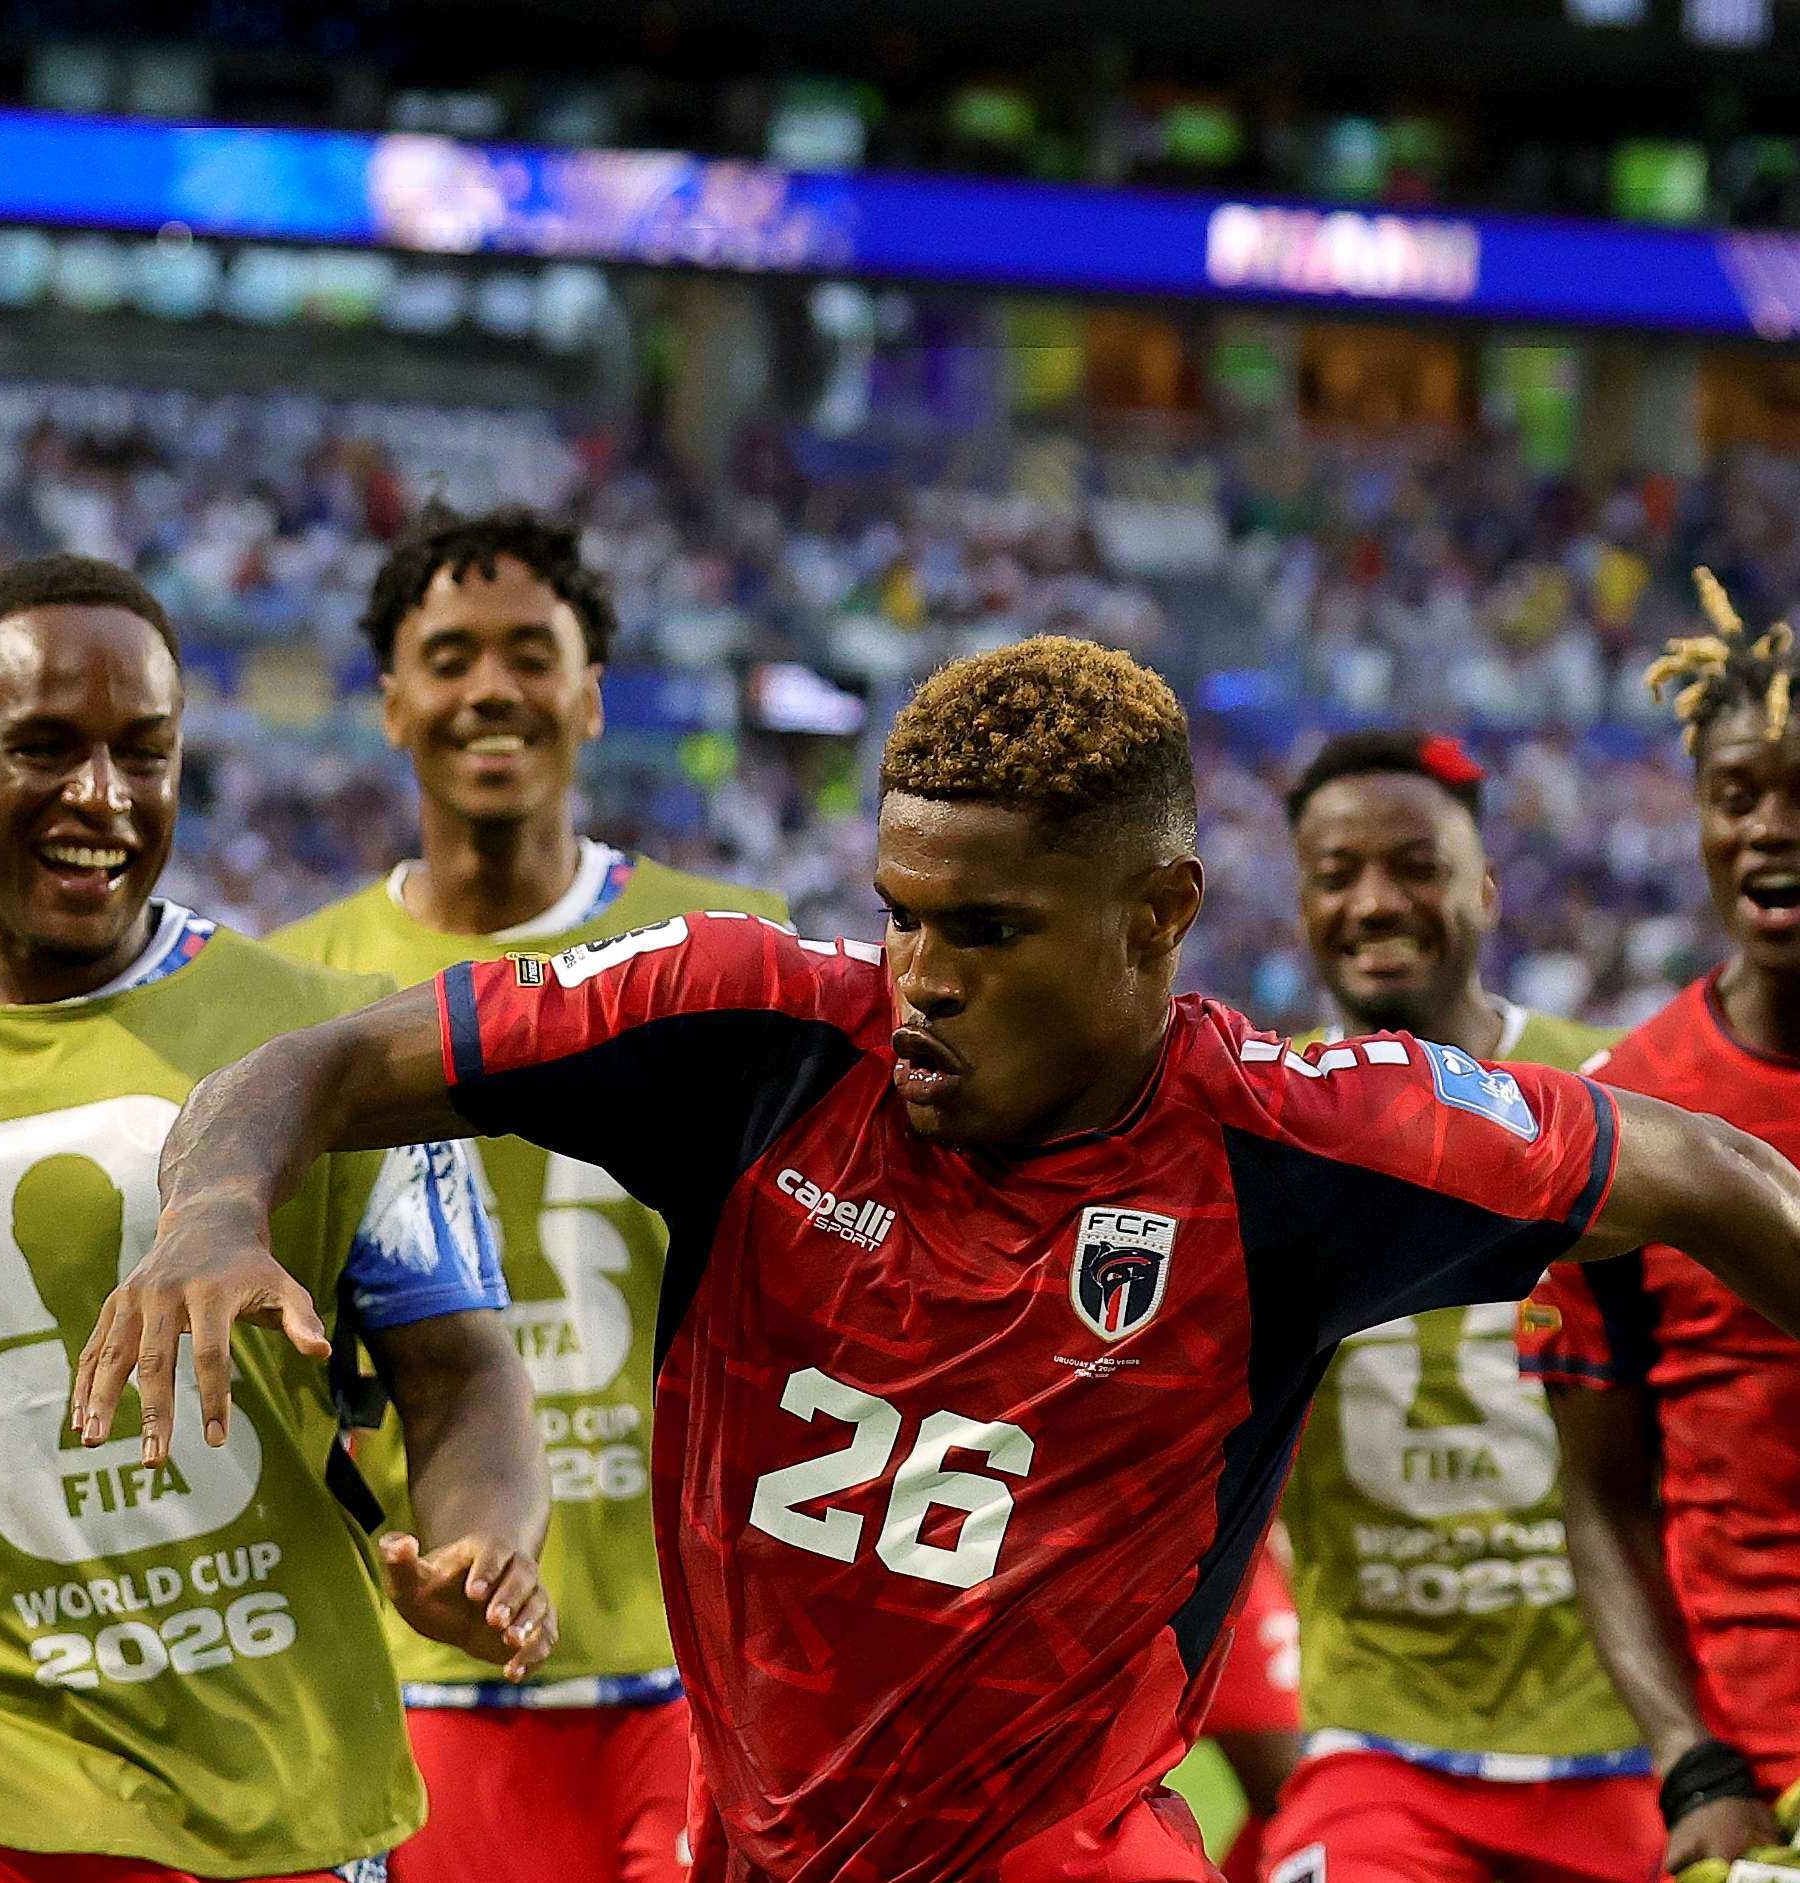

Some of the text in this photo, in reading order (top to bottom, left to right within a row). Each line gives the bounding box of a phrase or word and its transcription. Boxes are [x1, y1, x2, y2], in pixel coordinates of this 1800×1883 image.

[777, 1168, 896, 1243] capelli
[814, 1216, 881, 1252] SPORT
[1087, 1212, 1169, 1237] FCF
[61, 1459, 191, 1519] FIFA
[551, 1444, 648, 1500] 26
[749, 1366, 1035, 1589] 26
[12, 1540, 283, 1630] WORLD CUP
[30, 1590, 297, 1690] 2026
